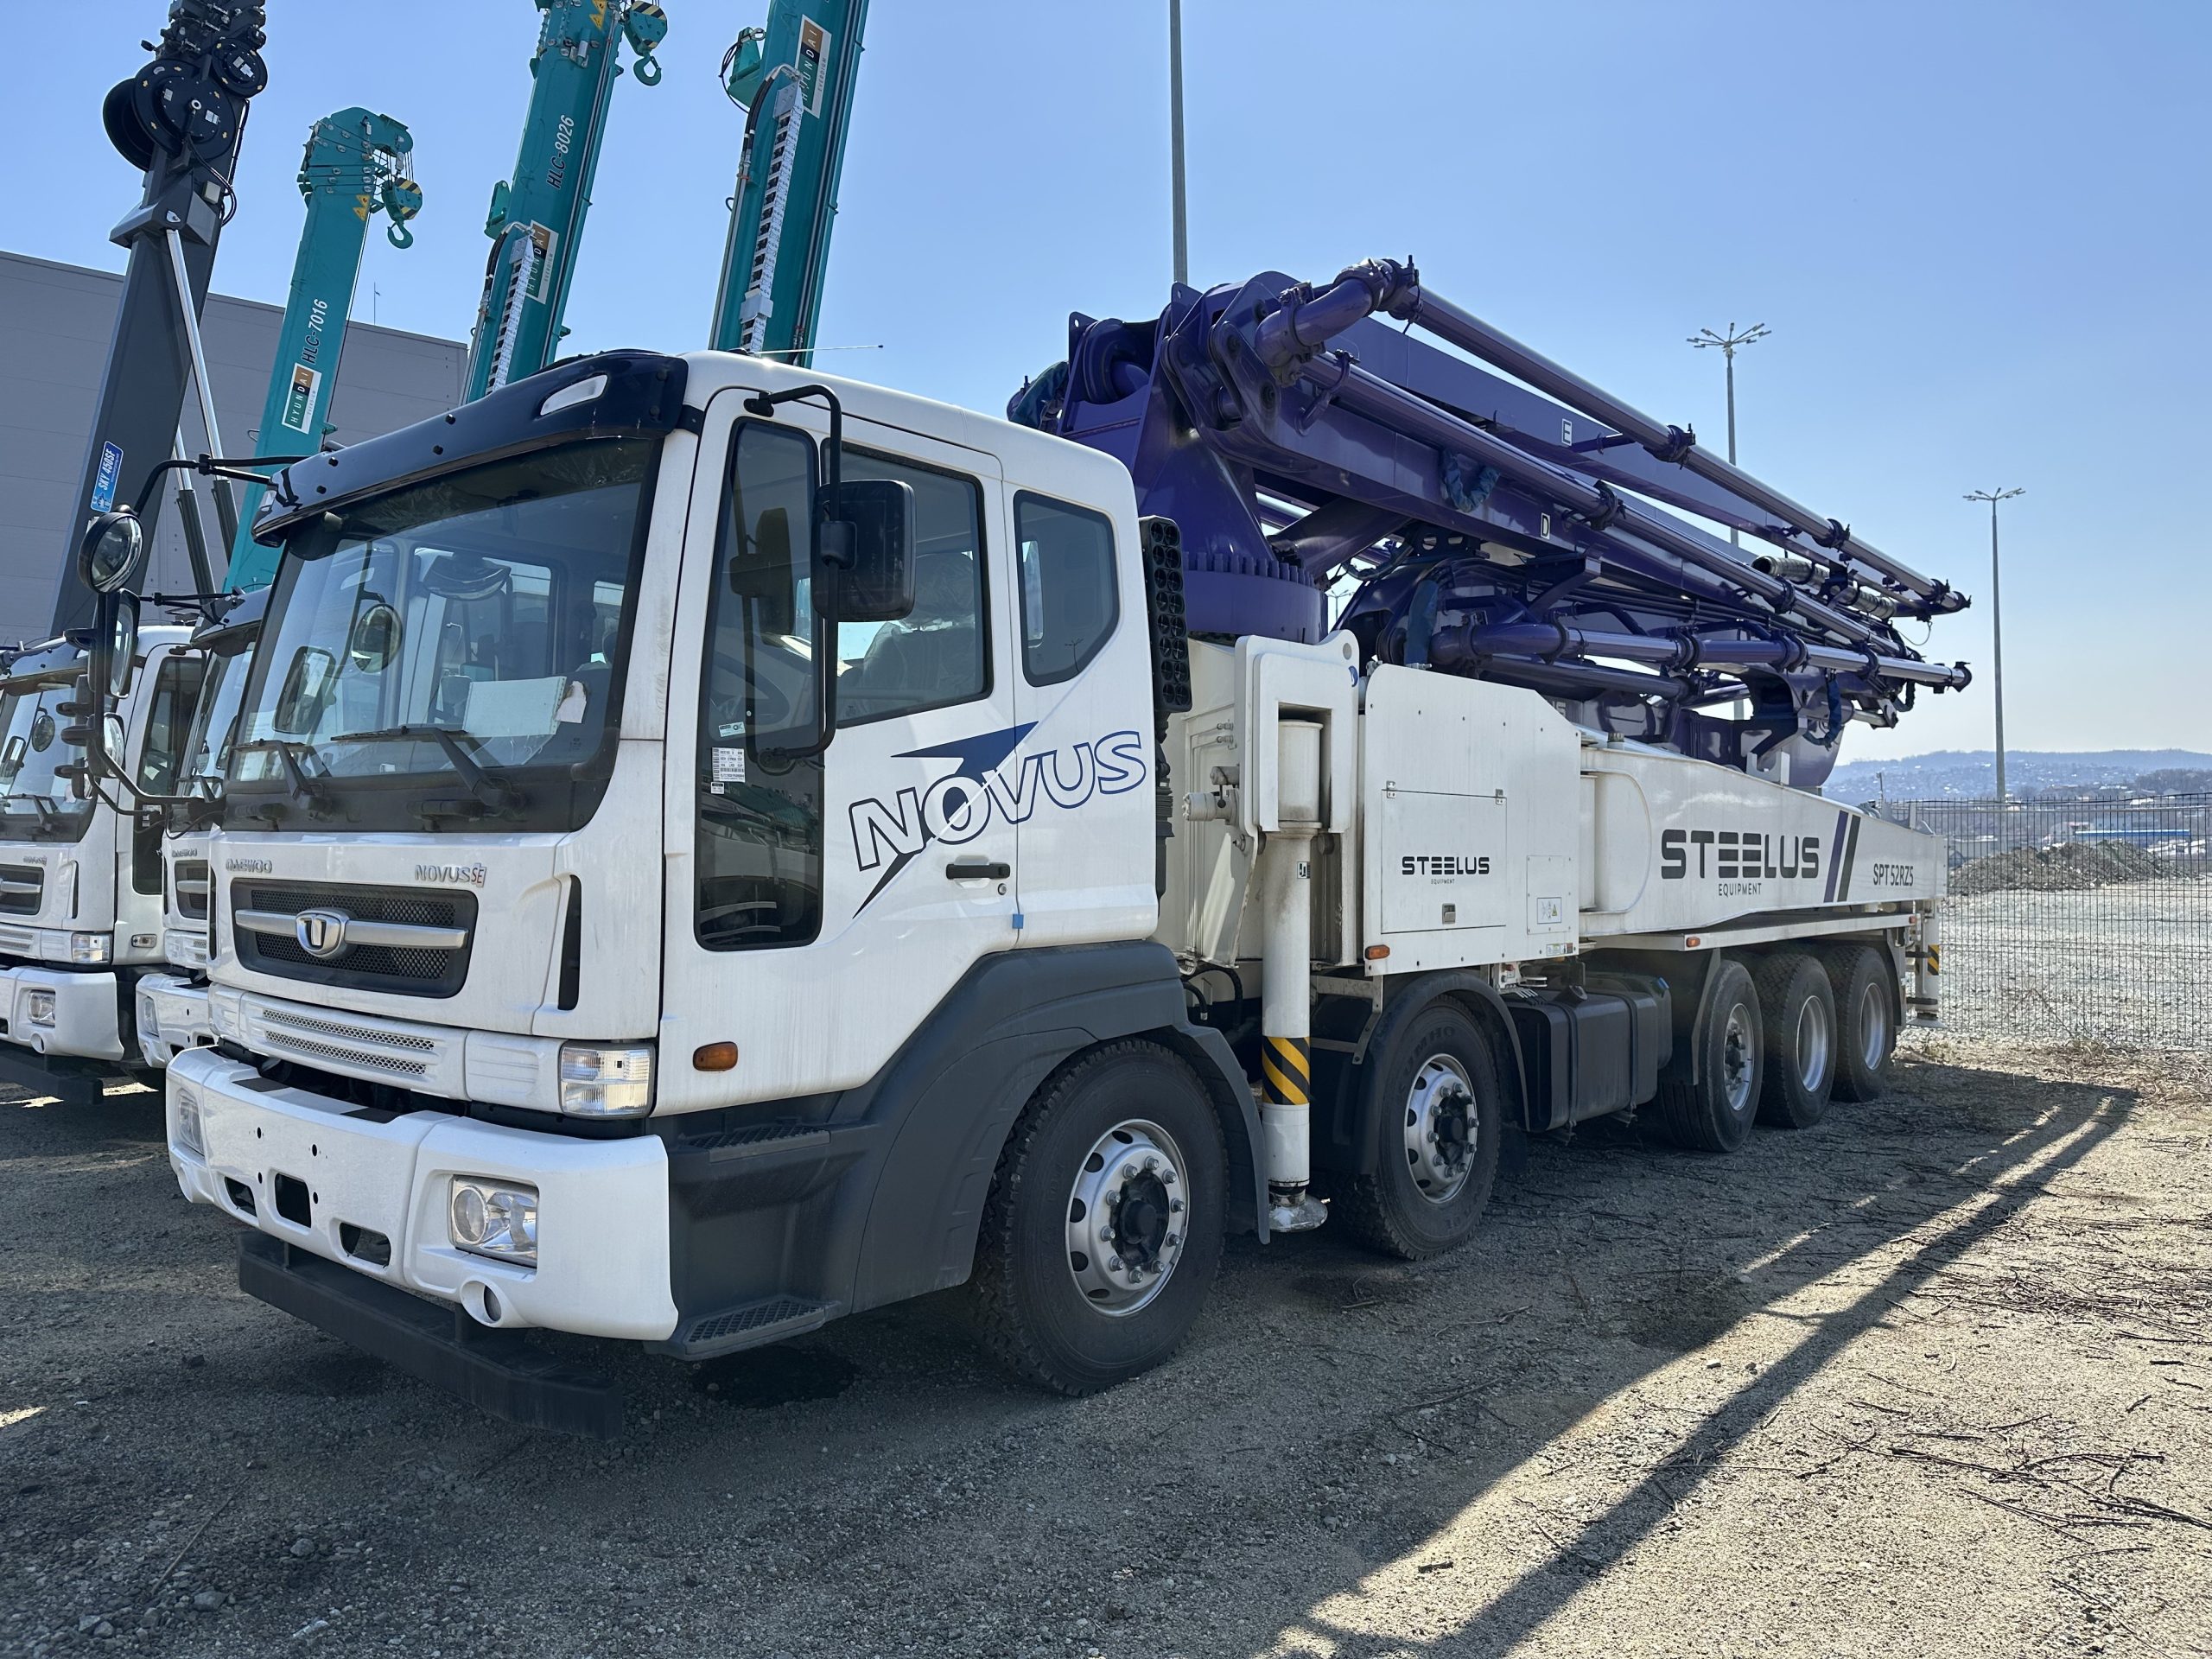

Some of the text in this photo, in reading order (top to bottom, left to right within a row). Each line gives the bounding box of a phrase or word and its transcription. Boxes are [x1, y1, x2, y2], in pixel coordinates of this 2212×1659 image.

[798, 29, 817, 101] HYUNDAI
[817, 57, 827, 92] EVERDIGM
[546, 114, 575, 189] HLC-8026
[527, 231, 545, 291] HYUNDAI
[301, 298, 328, 365] HLC-7016
[290, 372, 309, 423] HYUNDAI
[1562, 420, 1571, 444] E
[102, 448, 116, 474] 450SF
[98, 473, 110, 491] SKY
[1541, 514, 1549, 537] D
[849, 731, 1146, 872] NOVUS
[226, 858, 273, 874] DAEWOO
[1402, 856, 1490, 875] STEELUS
[1661, 829, 1820, 880] STEELUS
[1718, 883, 1762, 898] EQUIPMENT
